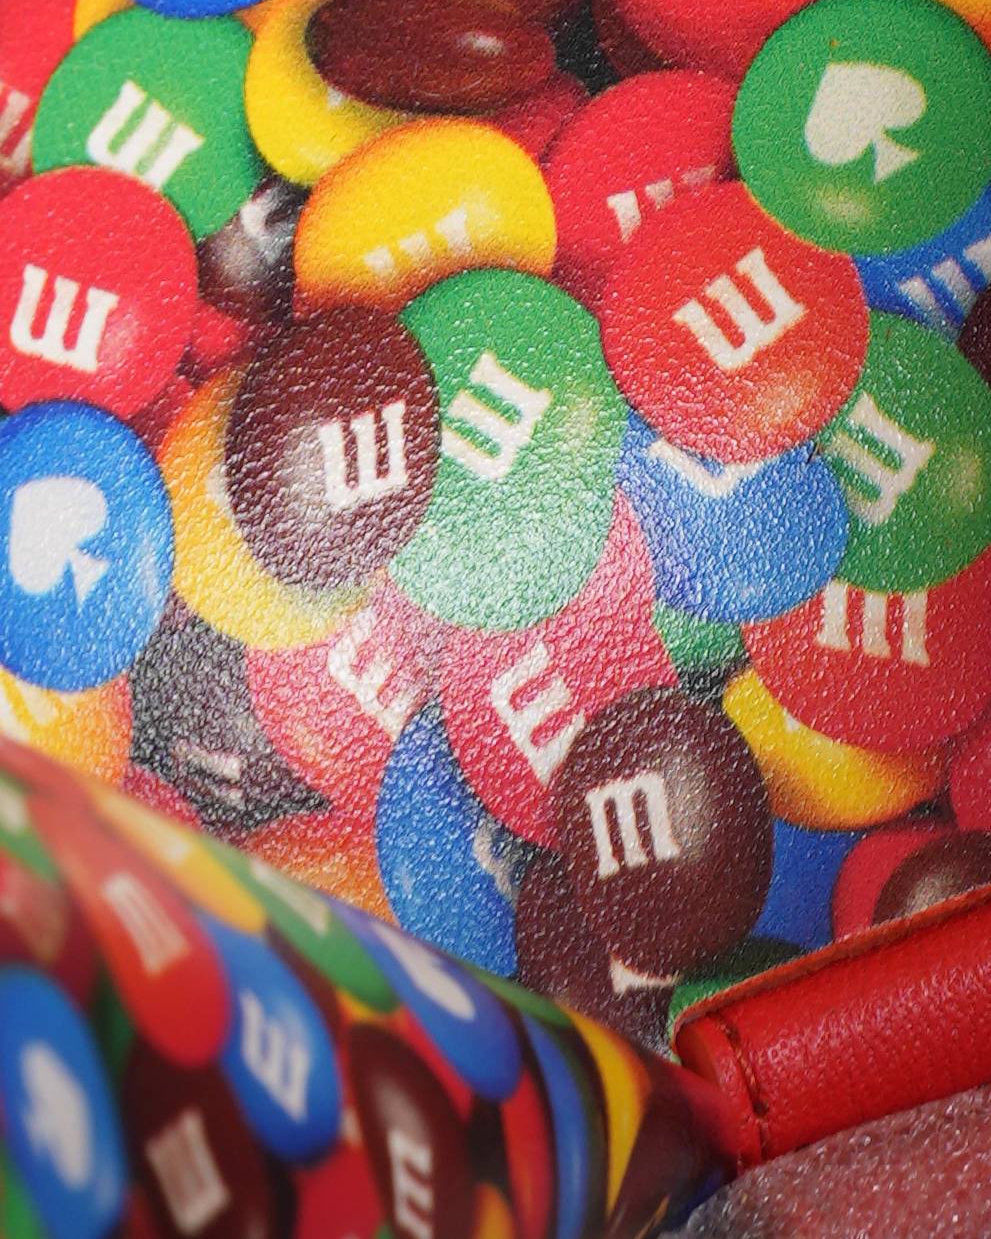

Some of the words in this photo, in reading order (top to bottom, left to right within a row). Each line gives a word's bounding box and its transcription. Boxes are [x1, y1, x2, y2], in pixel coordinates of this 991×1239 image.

[86, 78, 204, 192] m
[10, 263, 120, 373] m
[672, 247, 809, 373] m
[317, 399, 408, 509] m
[441, 351, 552, 481] m
[830, 391, 935, 525] m
[585, 772, 682, 880] m
